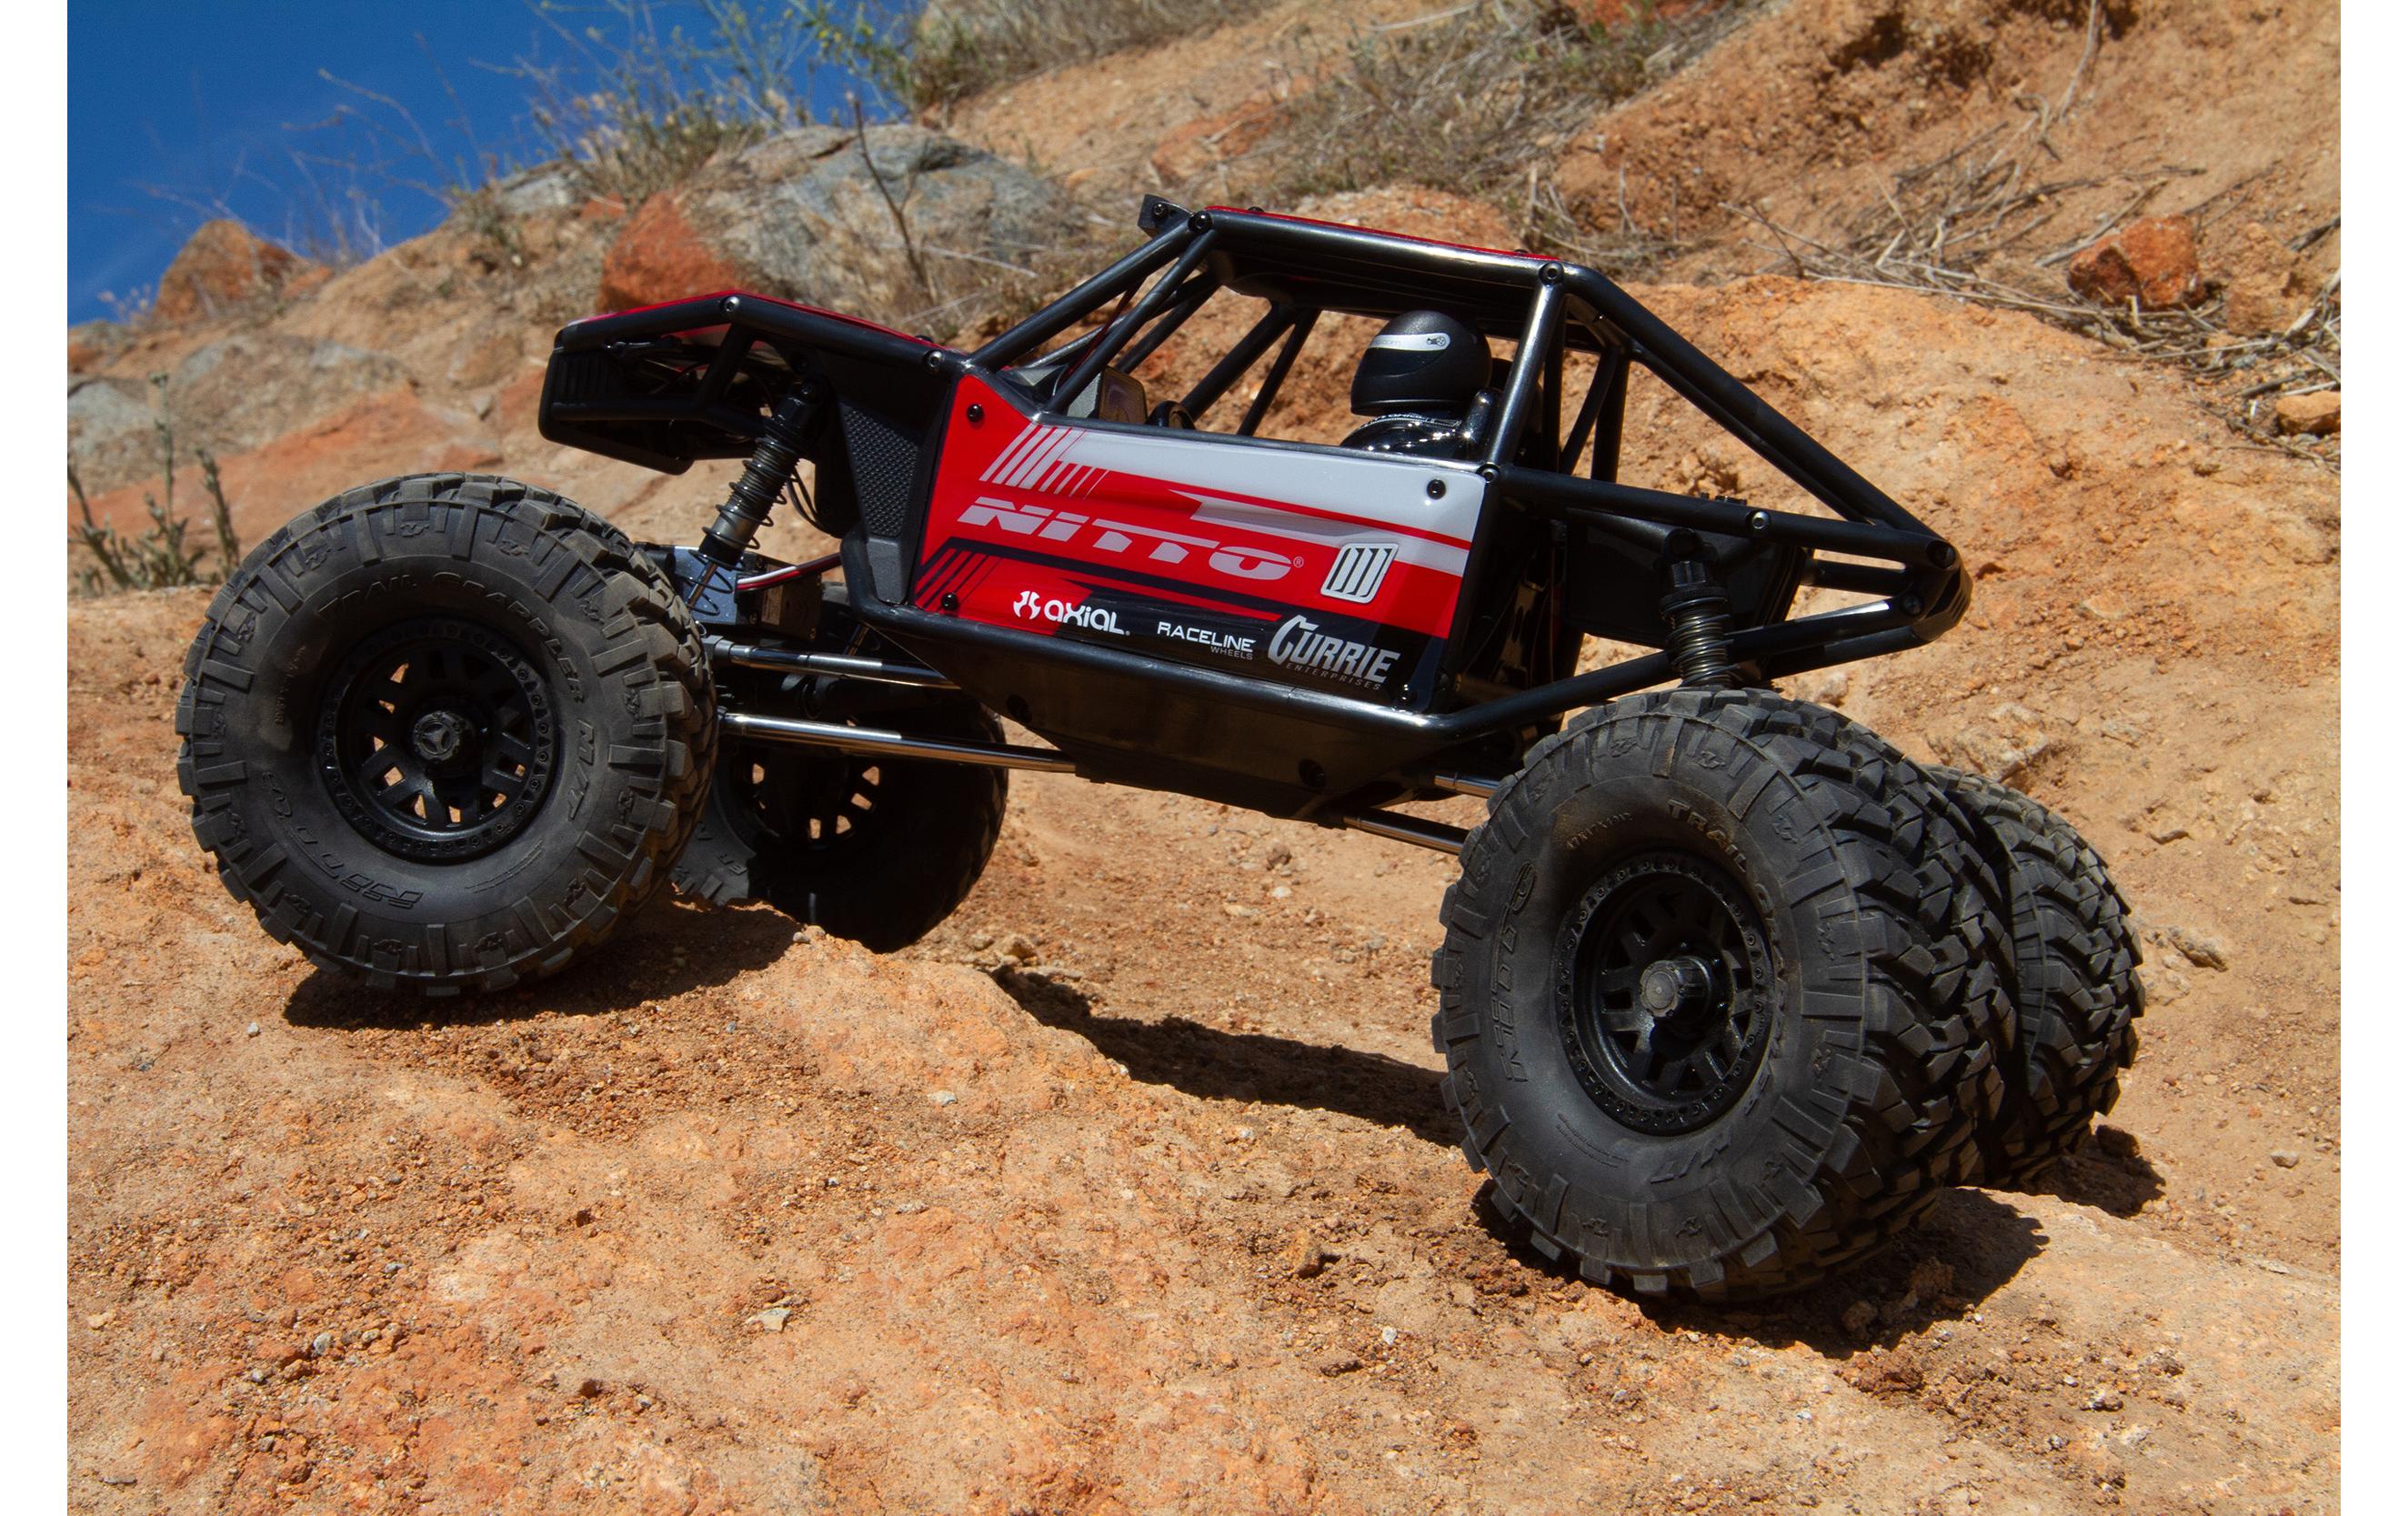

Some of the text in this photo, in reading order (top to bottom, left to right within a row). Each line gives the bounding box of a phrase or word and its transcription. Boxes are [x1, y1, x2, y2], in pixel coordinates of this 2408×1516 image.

[1157, 621, 1257, 653] RACELINE
[1210, 646, 1254, 660] WHEELS
[1268, 614, 1401, 684] CURRIE
[1286, 662, 1382, 690] ENTERPRISES
[1667, 798, 1748, 873] TRAIL
